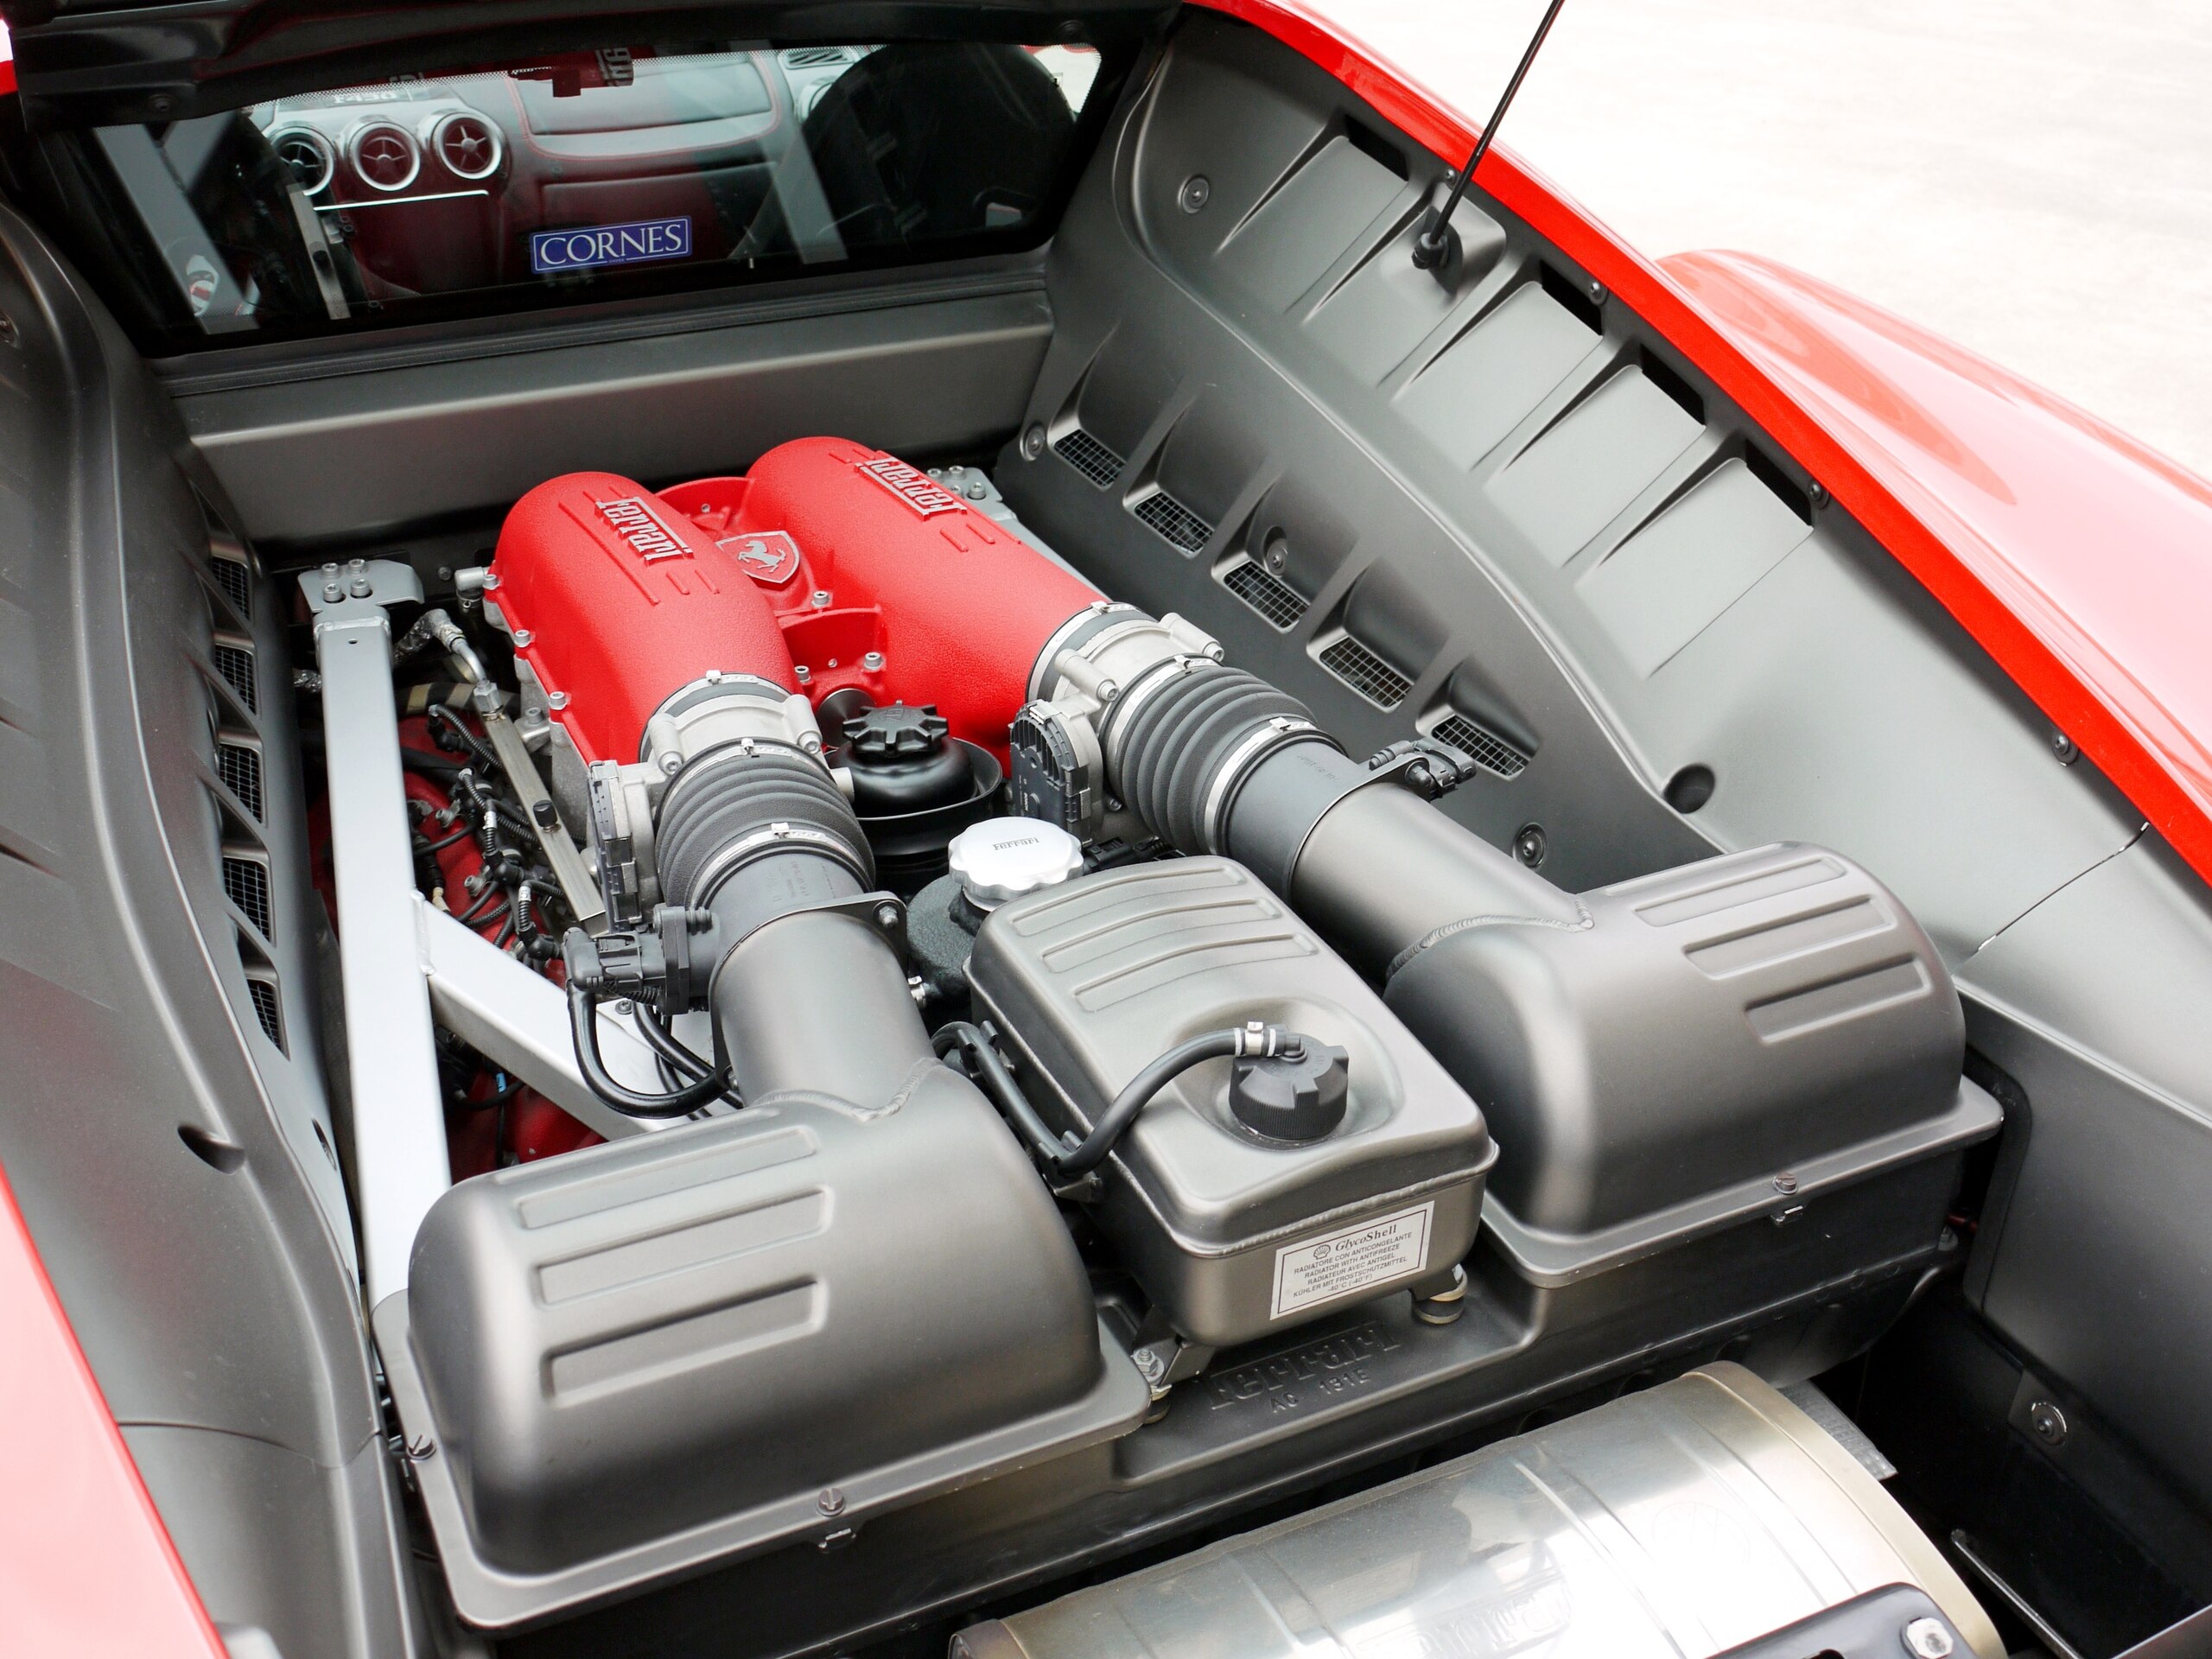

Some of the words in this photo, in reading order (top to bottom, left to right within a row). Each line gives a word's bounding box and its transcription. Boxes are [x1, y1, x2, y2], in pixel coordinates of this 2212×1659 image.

[540, 224, 682, 265] CORNES
[855, 456, 966, 520] Ferrari
[596, 496, 693, 564] Ferrari
[993, 836, 1039, 850] Ferrari
[1294, 1256, 1333, 1275] RADIATORE
[1334, 1251, 1351, 1262] CON
[1351, 1231, 1413, 1258] ANTICONGELANTE
[1335, 1224, 1397, 1251] GlycoShell
[1293, 1281, 1321, 1298] KÜHLER
[1322, 1278, 1335, 1288] MIT
[1335, 1255, 1408, 1285] FROSTSCHUTZMITTEL
[1304, 1262, 1339, 1279] RADIATOR
[1341, 1256, 1358, 1268] WITH
[1359, 1243, 1401, 1263] ANTIFREEZE
[1307, 1268, 1346, 1286] RADIATEUR
[1347, 1261, 1366, 1272] AVEC
[1367, 1252, 1395, 1267] ANTIGEL
[1269, 1391, 1300, 1414] AC
